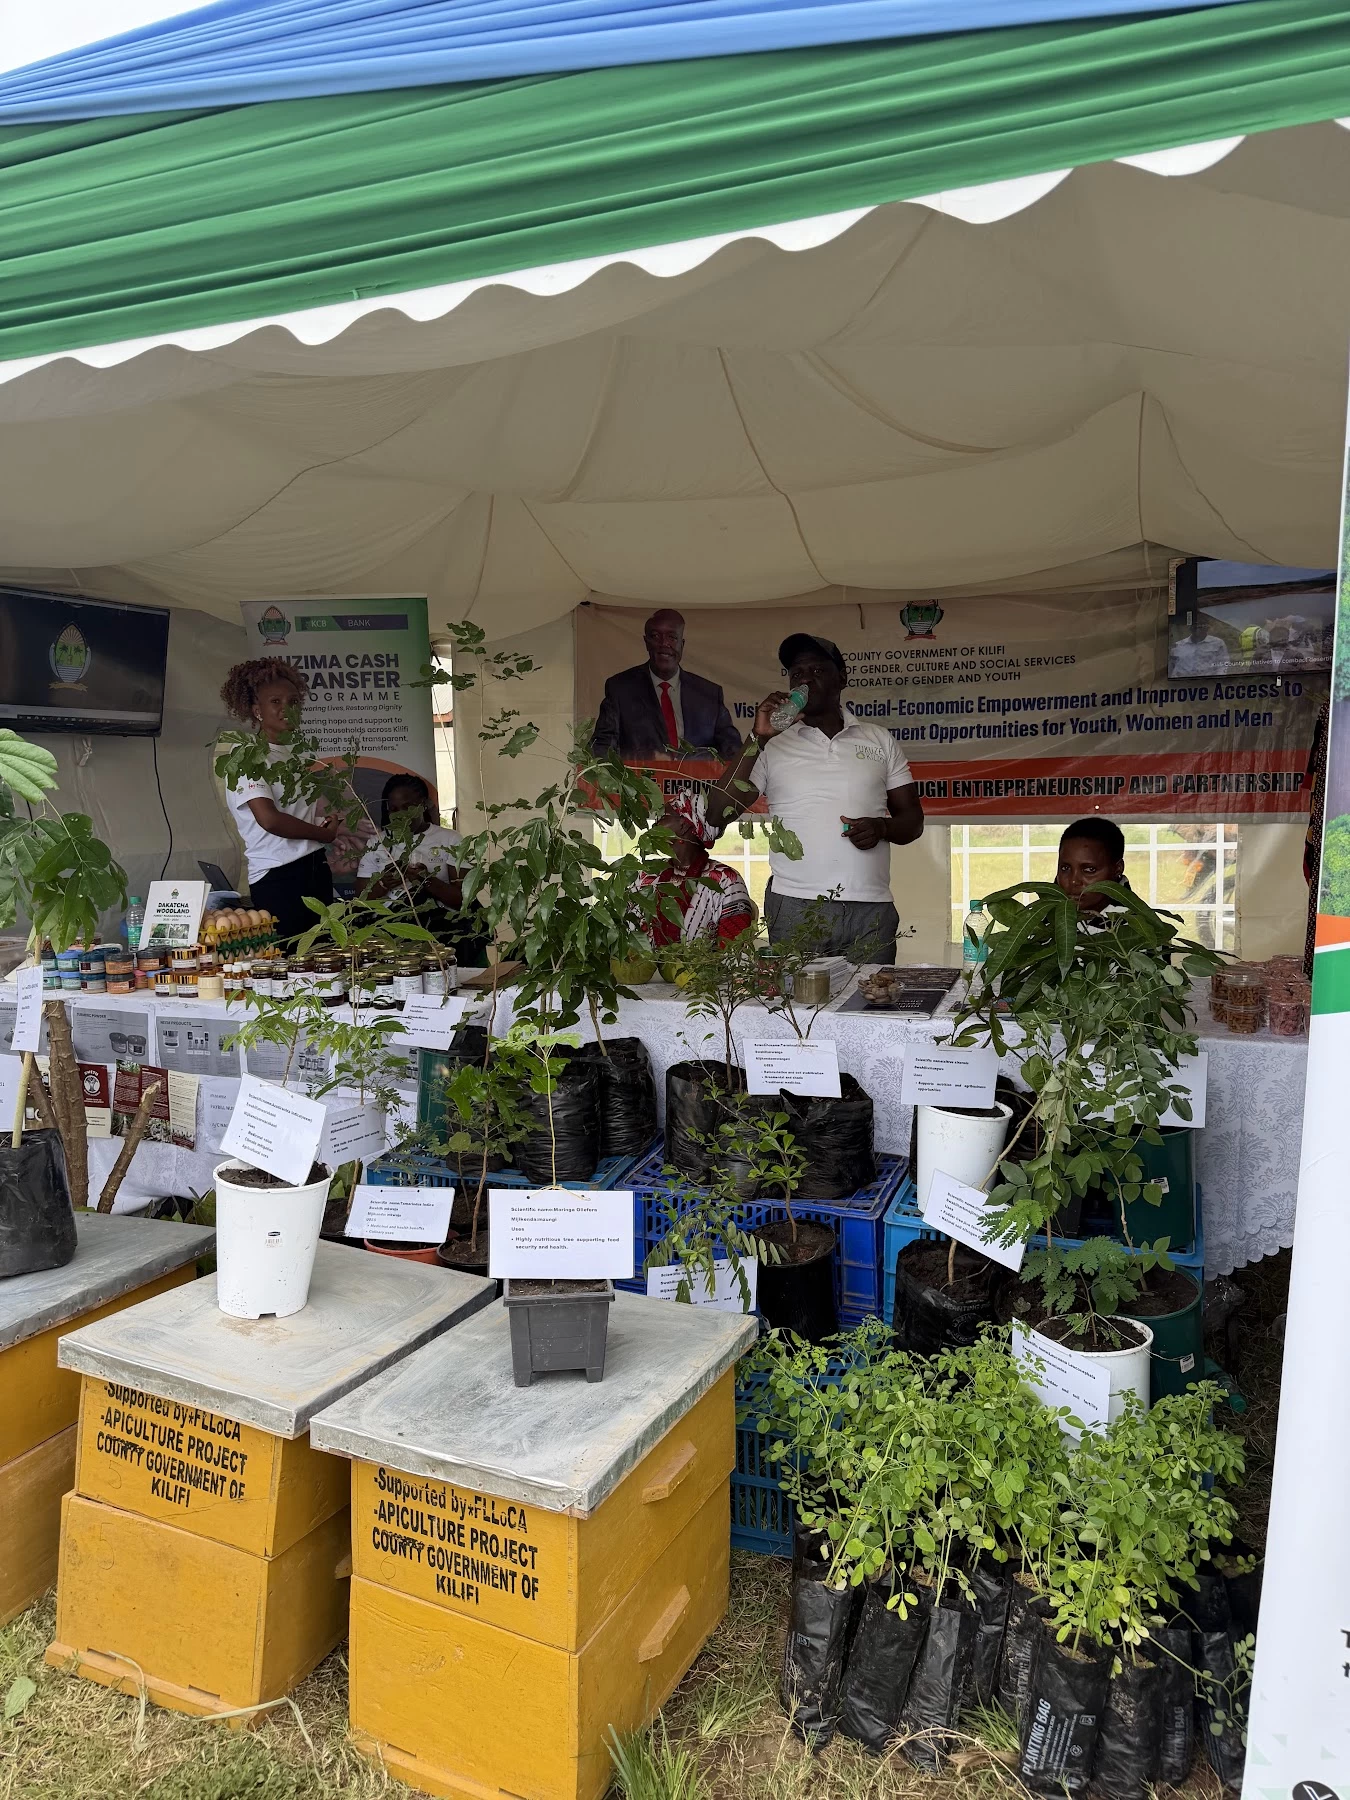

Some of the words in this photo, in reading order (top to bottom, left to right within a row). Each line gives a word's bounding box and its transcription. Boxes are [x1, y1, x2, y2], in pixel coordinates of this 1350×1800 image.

[311, 620, 327, 628] KCB
[348, 619, 370, 627] BANK
[345, 653, 399, 669] CASH
[841, 650, 882, 663] COUNTY
[886, 648, 957, 661] GOVERNMENT
[959, 645, 975, 657] OF
[977, 644, 1005, 656] KILIFI
[861, 663, 903, 675] GENDER,
[907, 660, 949, 672] CULTURE
[952, 660, 976, 671] AND
[979, 658, 1020, 669] SOCIAL
[1023, 655, 1075, 667] SERVICES
[302, 671, 401, 690] RANSFER
[894, 678, 907, 687] OF
[909, 676, 954, 687] GENDER
[957, 674, 981, 684] AND
[984, 671, 1020, 683] YOUTH
[309, 690, 401, 702] OGRAMME
[846, 698, 974, 718] Social-Economic
[977, 691, 1097, 716] Empowerment
[1101, 688, 1134, 707] and
[1136, 685, 1207, 707] Improve
[1212, 680, 1279, 701] Access
[1282, 680, 1303, 698] to
[346, 703, 378, 712] Restoring
[378, 703, 403, 713] Dignity
[323, 726, 366, 735] households
[393, 725, 408, 733] Kilifi
[328, 717, 347, 727] hope
[364, 717, 393, 727] support
[929, 721, 1039, 746] Opportunities
[1042, 718, 1066, 736] for
[1069, 715, 1121, 736] Youth,
[1126, 713, 1193, 733] Women
[1196, 710, 1230, 729] and
[1233, 708, 1273, 727] Men
[362, 735, 409, 745] transparent,
[951, 774, 1125, 798] ENTREPRENEURSHIP
[1128, 775, 1167, 796] AND
[1171, 771, 1305, 795] PARTNERSHIP
[97, 1430, 145, 1466] COUNTY
[146, 1449, 227, 1498] GOVERNMENT
[229, 1479, 246, 1499] OF
[187, 1434, 248, 1476] PROJECT
[151, 1476, 191, 1508] KILIFI
[470, 1526, 538, 1570] PROJECT
[373, 1526, 425, 1563] COUNTY
[427, 1544, 517, 1595] GOVERNMENT
[521, 1572, 539, 1601] OF
[436, 1573, 480, 1606] KILIFI
[1174, 1706, 1185, 1728] BAG
[1022, 1720, 1047, 1776] PLANTING
[1035, 1698, 1051, 1727] BAG
